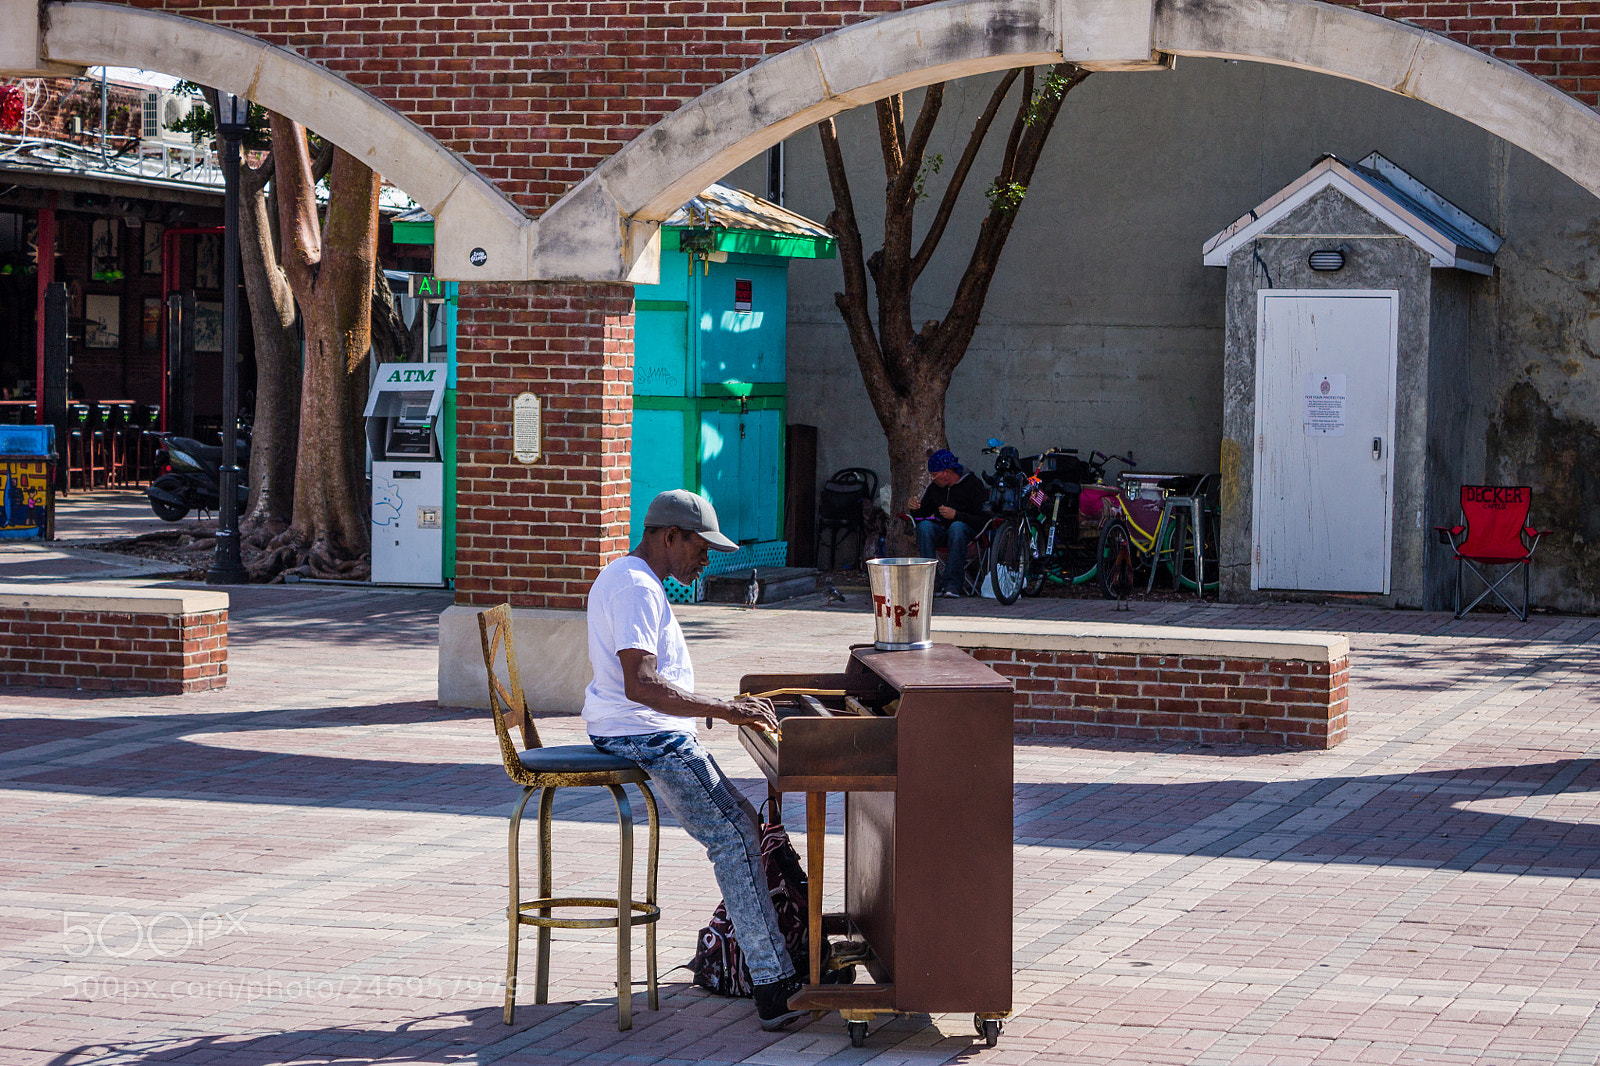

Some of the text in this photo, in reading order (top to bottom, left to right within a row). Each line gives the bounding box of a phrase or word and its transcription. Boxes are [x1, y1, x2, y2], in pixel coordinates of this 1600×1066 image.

[418, 276, 442, 295] AT
[386, 369, 437, 382] ATM
[1466, 486, 1523, 503] DECKER
